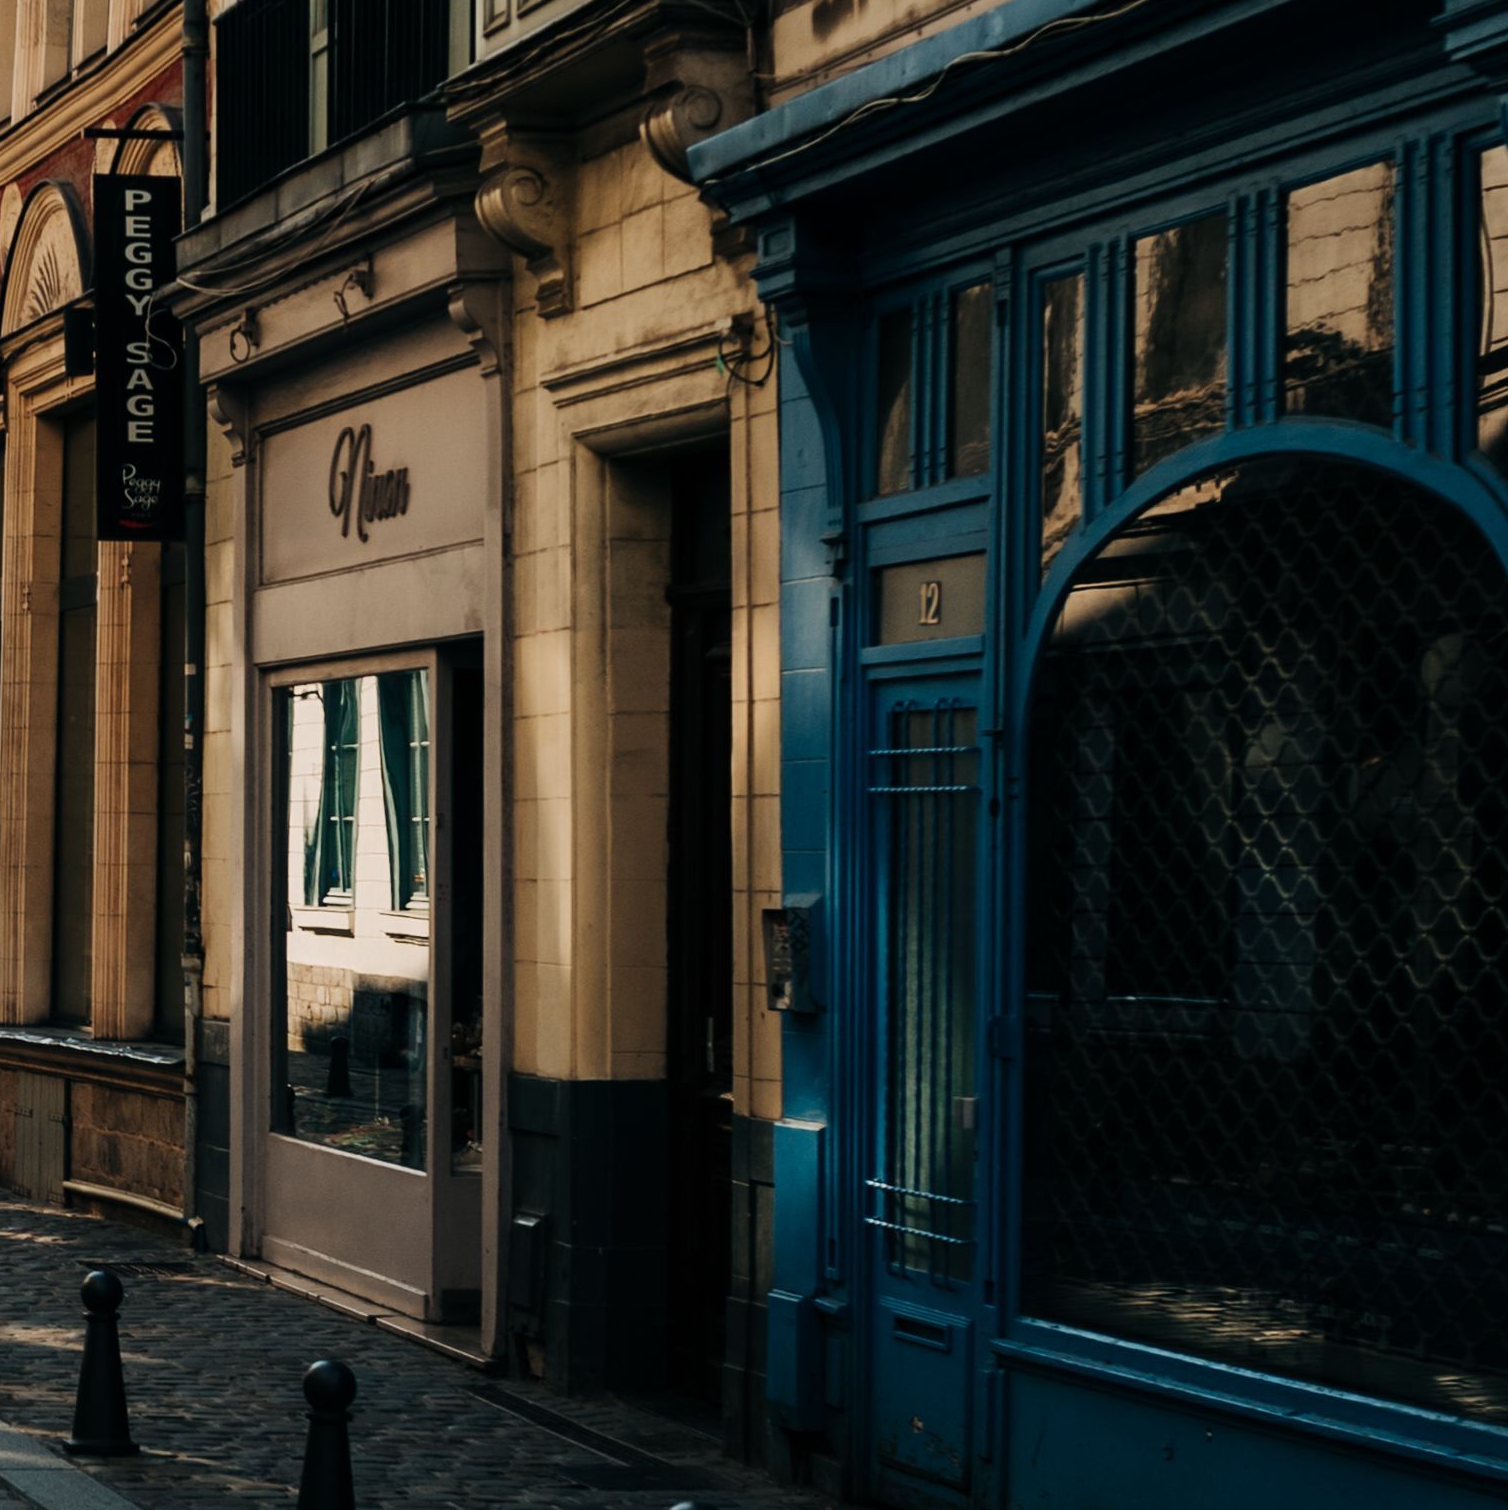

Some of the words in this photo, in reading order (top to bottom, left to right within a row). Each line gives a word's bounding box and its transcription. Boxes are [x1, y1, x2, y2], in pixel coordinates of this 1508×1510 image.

[124, 189, 153, 317] PEGGY
[125, 342, 155, 443] SAGE
[122, 463, 161, 494] Peggy
[122, 488, 158, 511] Sage
[918, 582, 940, 624] 12
